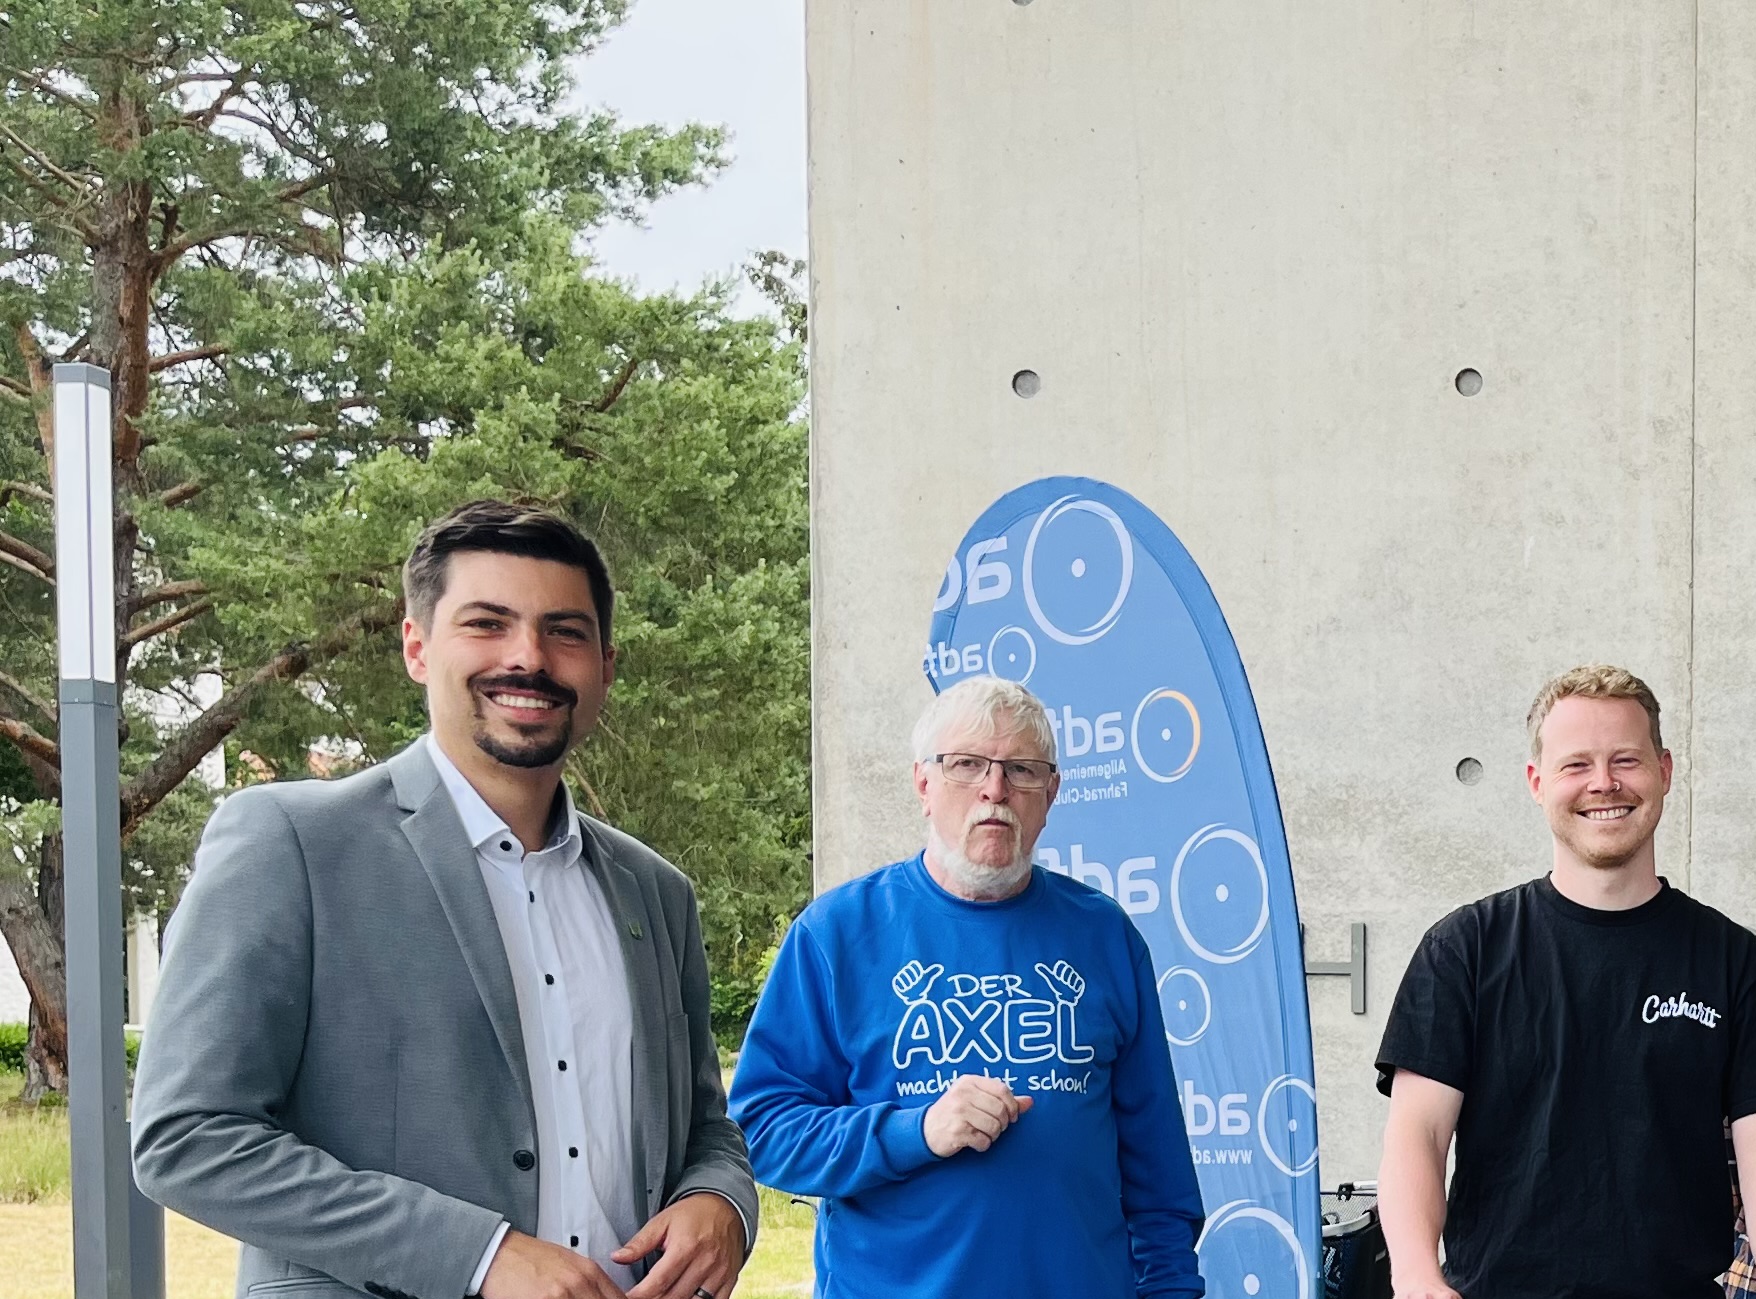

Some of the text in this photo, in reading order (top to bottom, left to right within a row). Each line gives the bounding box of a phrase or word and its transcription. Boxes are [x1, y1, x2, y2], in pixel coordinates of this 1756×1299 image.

[947, 974, 1032, 997] DER
[1642, 991, 1722, 1028] Carhartt
[893, 998, 1095, 1070] AXEL
[1028, 1068, 1091, 1094] schon!
